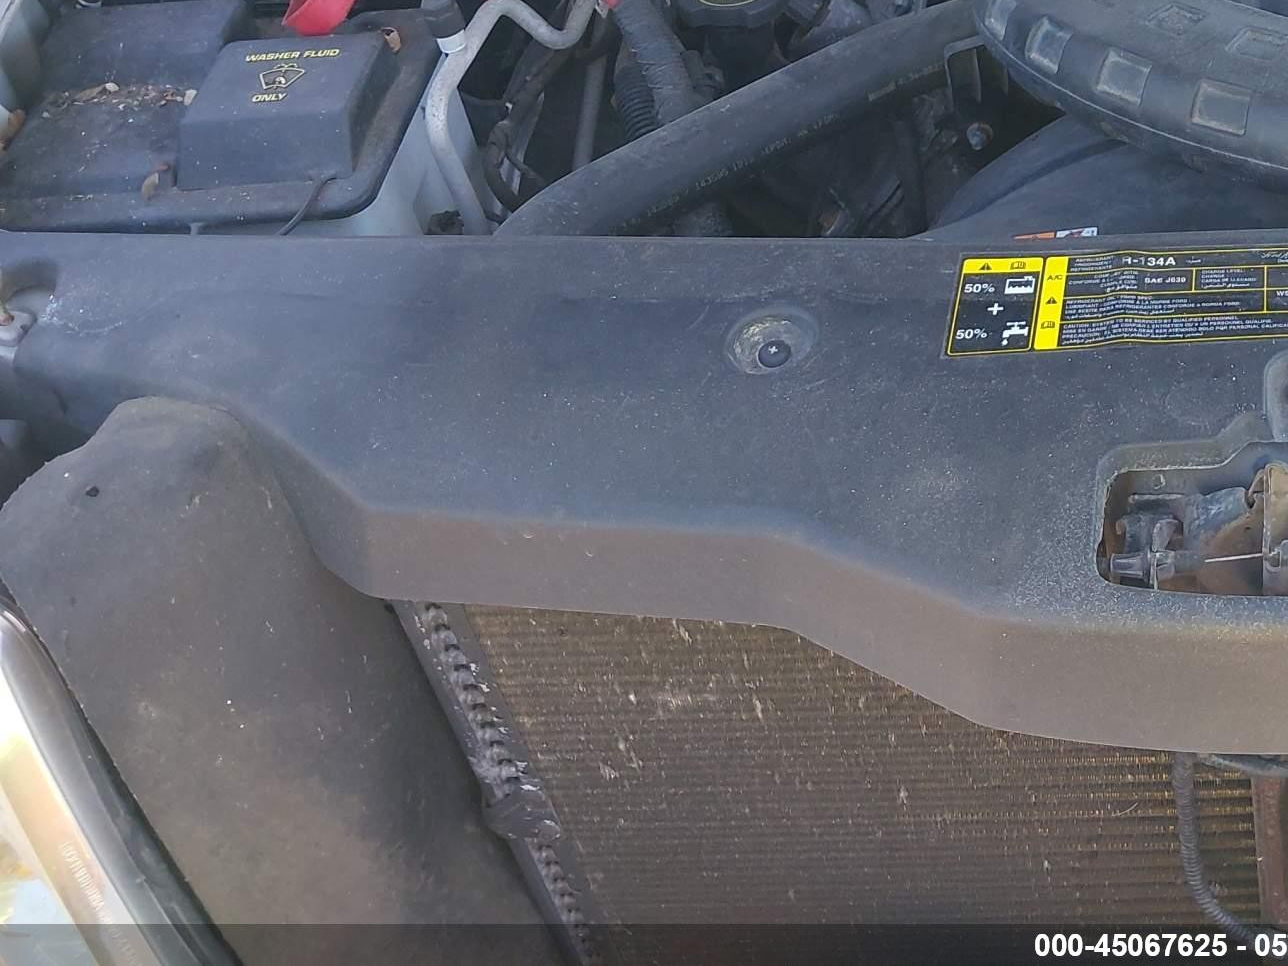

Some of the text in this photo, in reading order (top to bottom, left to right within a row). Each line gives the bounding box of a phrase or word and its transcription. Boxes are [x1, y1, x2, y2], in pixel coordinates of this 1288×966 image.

[245, 48, 340, 62] WASHER FLUID
[252, 92, 287, 103] ONLY
[963, 283, 995, 294] 50%
[955, 328, 988, 339] 50%
